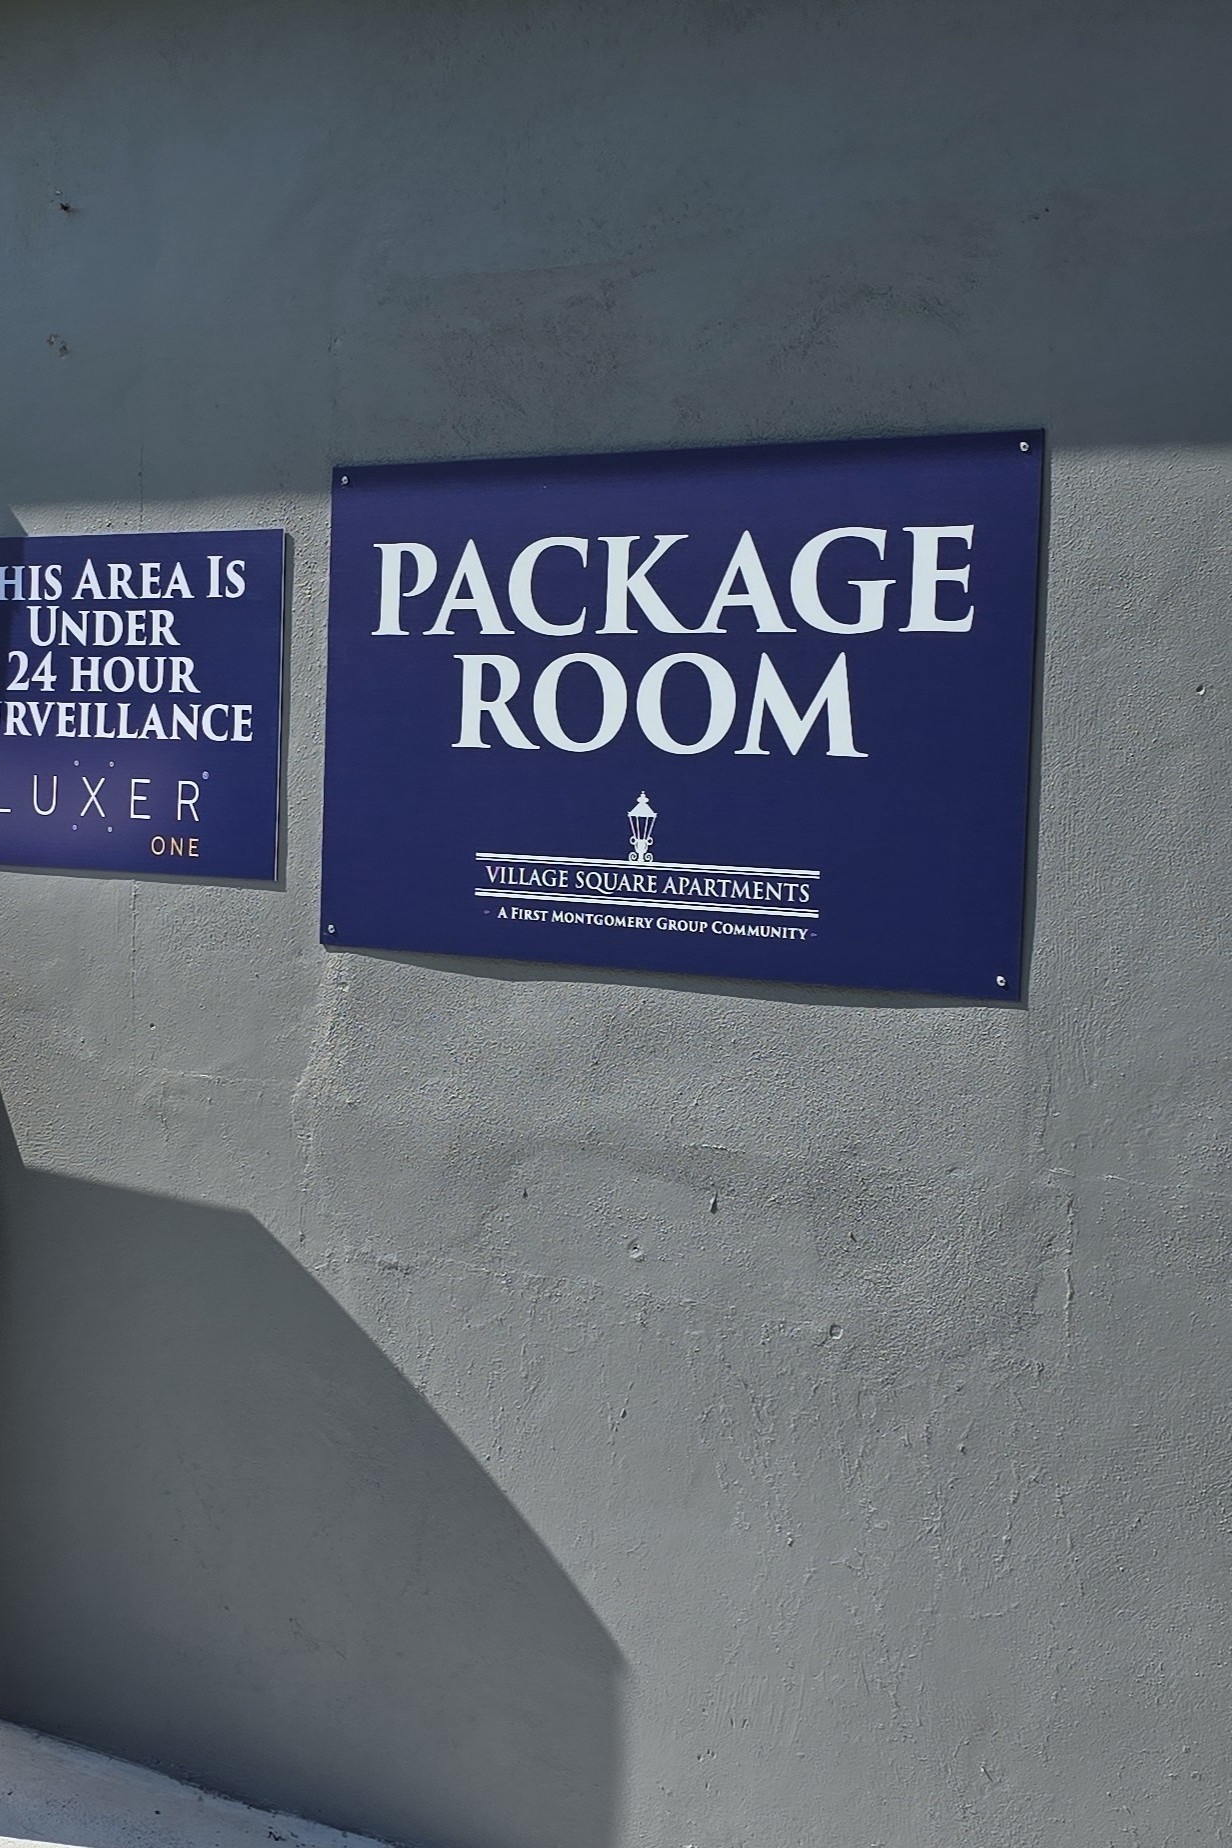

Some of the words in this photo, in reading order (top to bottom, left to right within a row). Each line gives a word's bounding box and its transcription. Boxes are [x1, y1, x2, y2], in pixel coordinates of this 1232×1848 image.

[71, 558, 195, 600] AREA
[207, 555, 246, 599] IS
[371, 525, 975, 636] PACKAGE
[26, 605, 181, 647] UNDER
[6, 650, 57, 692] 24
[70, 656, 201, 694] HOUR
[451, 652, 869, 758] ROOM
[151, 836, 200, 858] ONE
[485, 865, 569, 888] VILLAGE
[575, 870, 658, 895] SQUARE
[662, 876, 810, 903] APARTMENTS
[497, 907, 508, 919] A
[511, 907, 549, 922] FIRST
[551, 910, 654, 929] MONTGOMERY
[656, 917, 708, 933] GROUP
[711, 921, 809, 940] COMMUNITY
